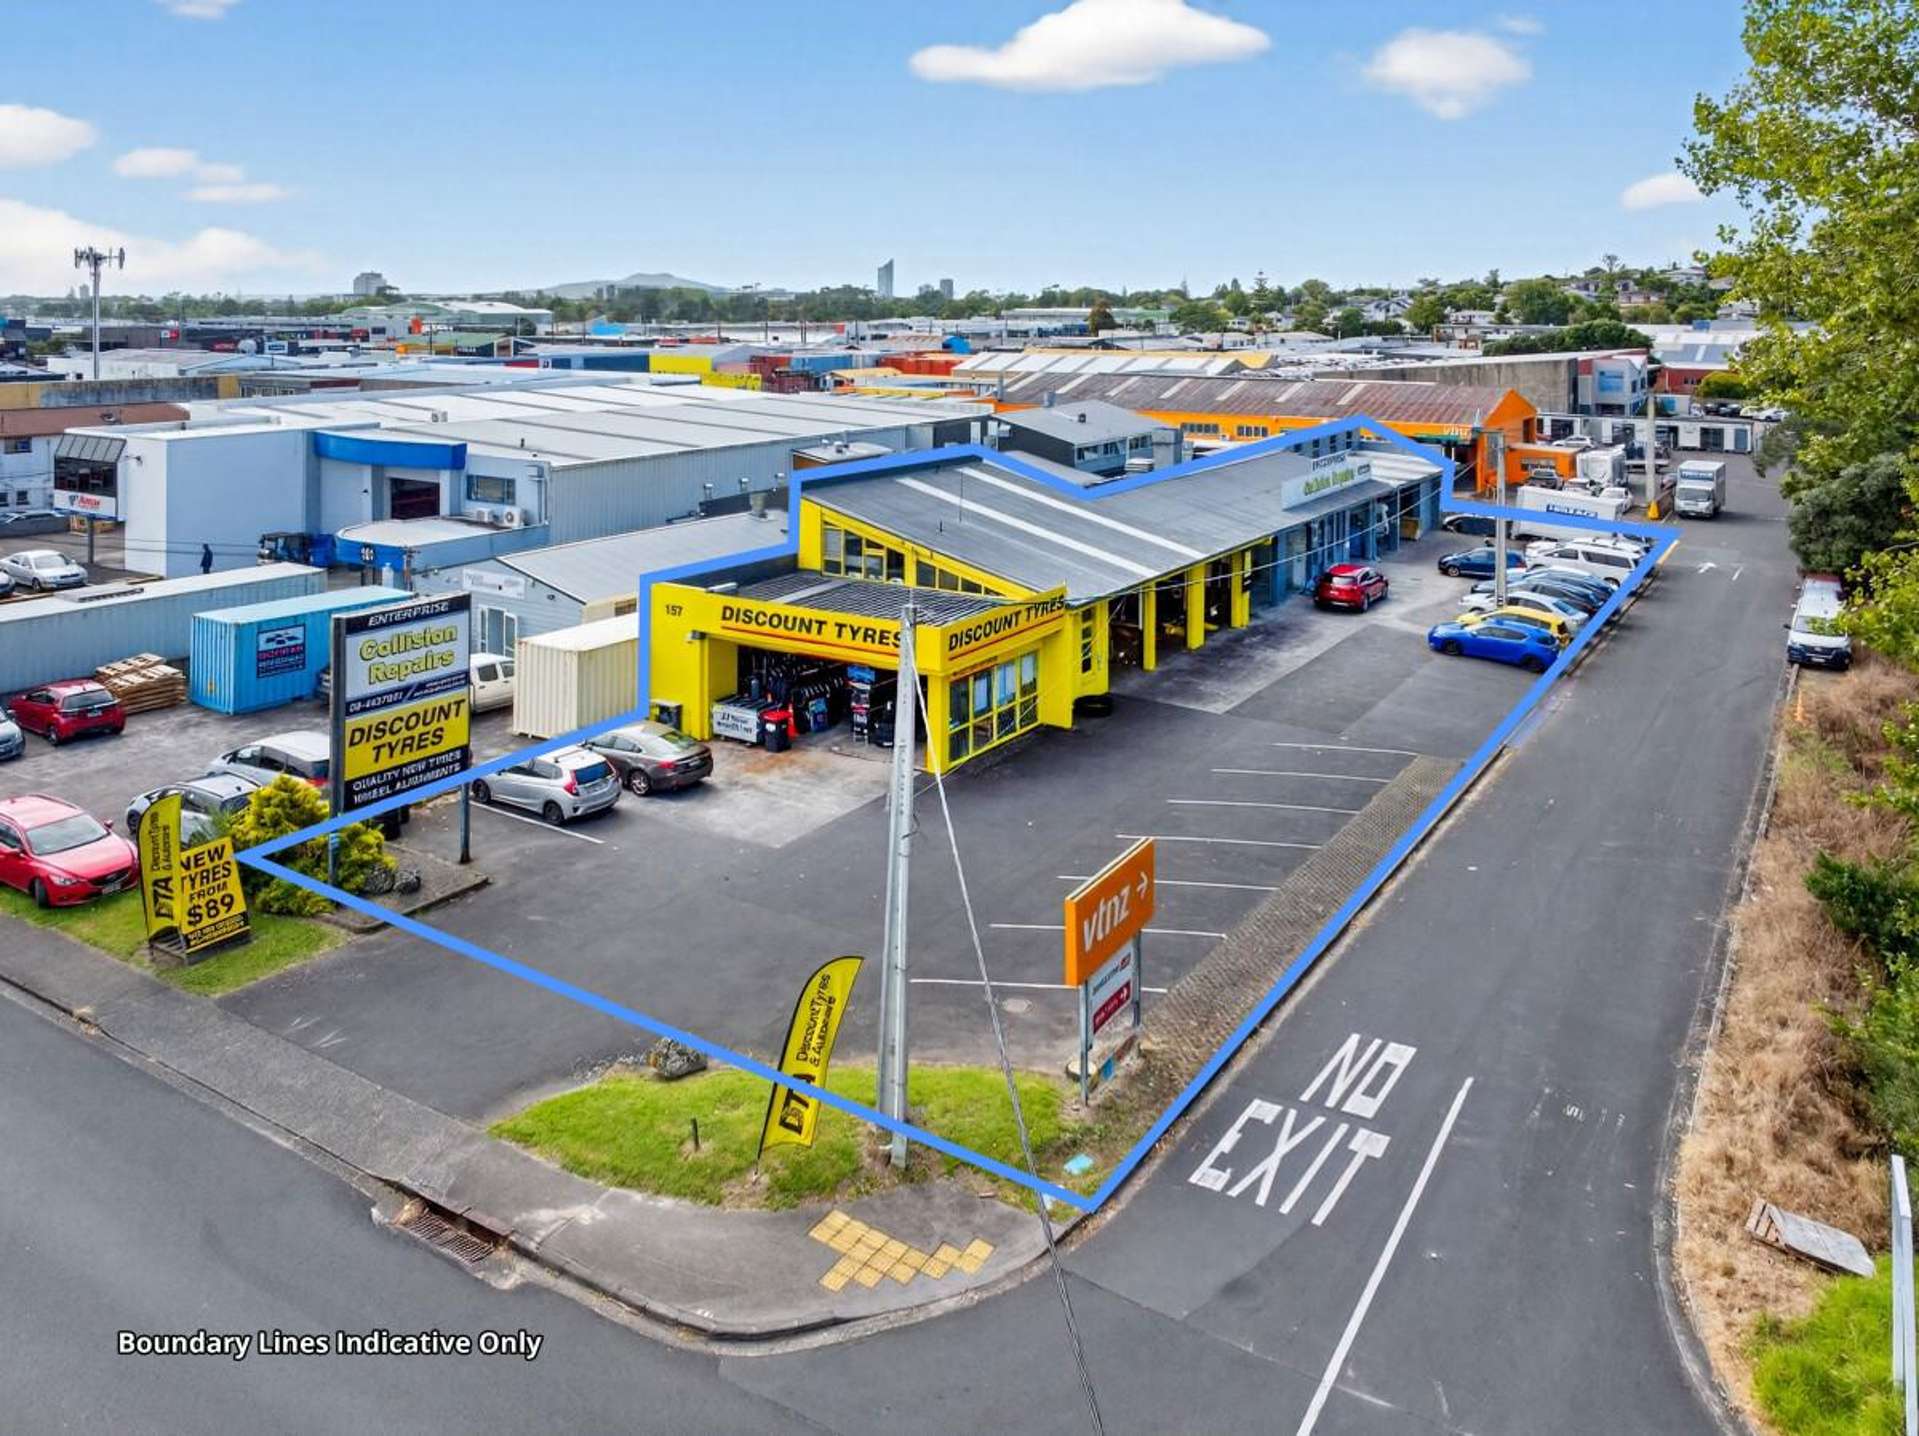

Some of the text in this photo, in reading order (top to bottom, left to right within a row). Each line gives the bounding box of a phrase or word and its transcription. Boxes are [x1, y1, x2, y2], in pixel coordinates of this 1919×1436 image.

[368, 601, 449, 627] ENTERPRISE
[665, 604, 683, 617] 157
[722, 605, 901, 649] DISCOUNT TYRES
[949, 594, 1065, 652] DISCOUNT TYRES
[359, 624, 458, 662] Collision
[368, 648, 455, 686] Repairs
[348, 698, 466, 748] DISCOUNT
[372, 727, 444, 763] TYRES
[352, 768, 401, 791] QUALITY
[180, 844, 227, 872] NEW
[181, 860, 232, 894] TYRES
[189, 880, 228, 903] FROM
[187, 893, 235, 927] $89
[1083, 883, 1131, 953] vtnz
[1300, 1033, 1417, 1119] NO
[1187, 1098, 1391, 1227] EXIT
